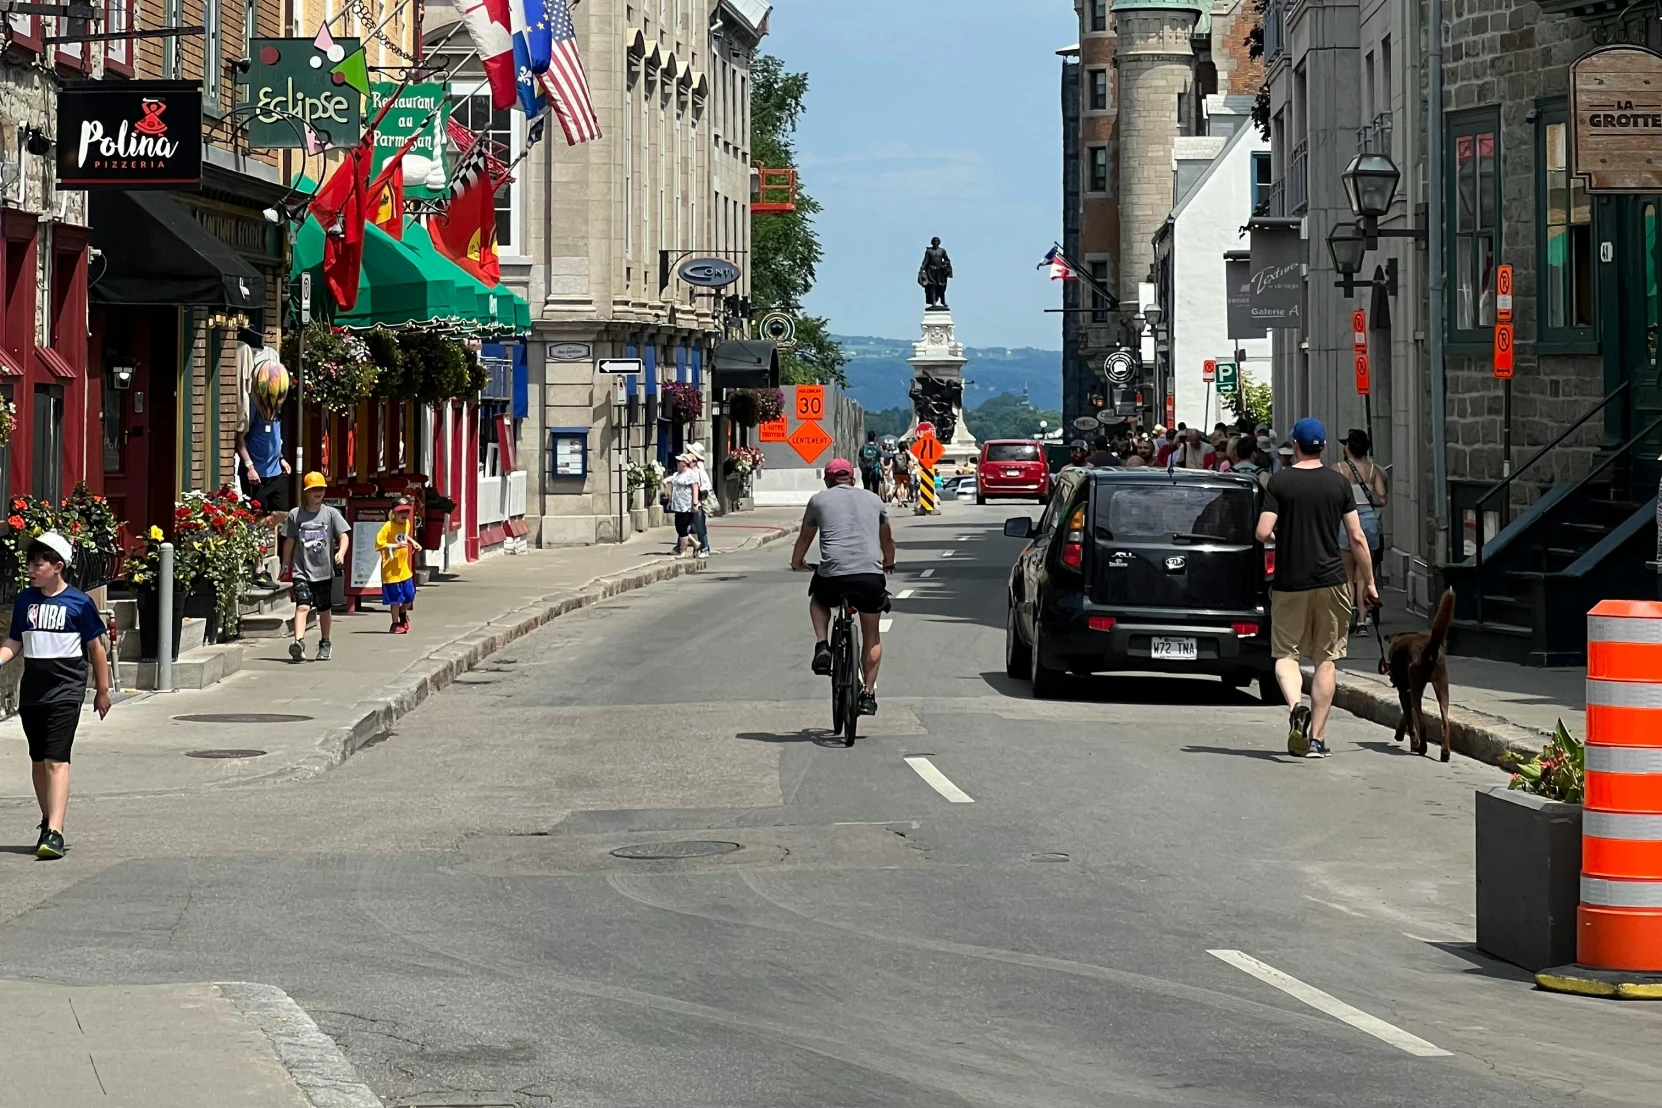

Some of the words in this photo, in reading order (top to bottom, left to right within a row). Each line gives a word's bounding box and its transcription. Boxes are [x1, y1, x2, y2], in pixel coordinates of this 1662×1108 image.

[372, 91, 435, 112] Retaurant
[1616, 100, 1634, 111] LA
[398, 116, 413, 128] au
[1589, 113, 1662, 128] GROTTE
[78, 119, 179, 169] Polina
[94, 160, 165, 169] PIZZERIA
[1251, 307, 1285, 316] Galerie
[1288, 304, 1299, 317] A
[1218, 364, 1233, 382] P
[799, 397, 822, 415] 30
[792, 437, 827, 445] LENTEMENT
[38, 603, 67, 631] NBA
[1153, 642, 1171, 654] W72
[1177, 642, 1195, 655] TNA
